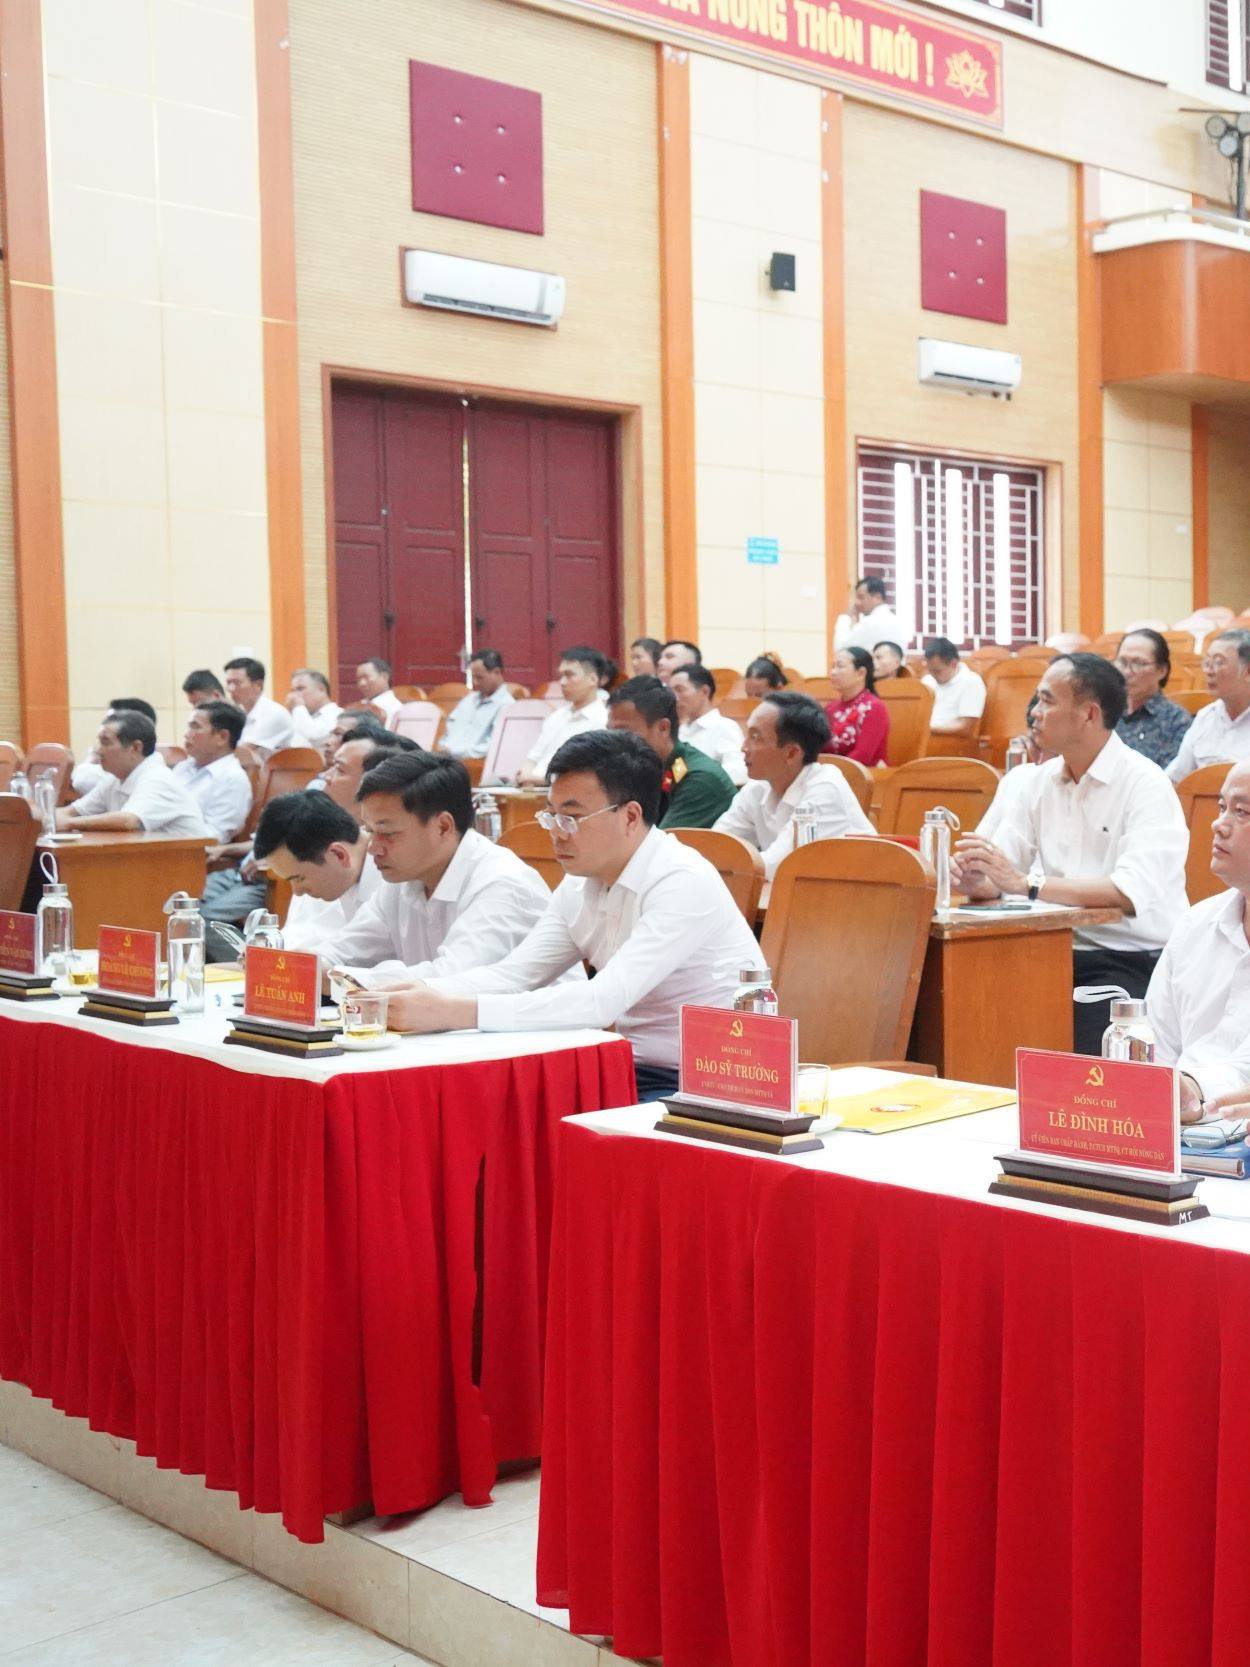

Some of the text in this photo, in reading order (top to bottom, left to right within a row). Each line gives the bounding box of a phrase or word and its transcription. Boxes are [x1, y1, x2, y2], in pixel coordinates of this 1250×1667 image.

[794, 1, 863, 66] THÔN
[870, 24, 918, 82] MỚI
[288, 991, 305, 1005] ANH
[696, 1055, 717, 1074] ĐÀO
[734, 1062, 779, 1084] TRƯỜNG
[1073, 1094, 1117, 1109] ĐỒNG CHÍ
[1048, 1108, 1145, 1139] LÊ ĐÌNH HÓA
[1178, 1210, 1193, 1225] MT
